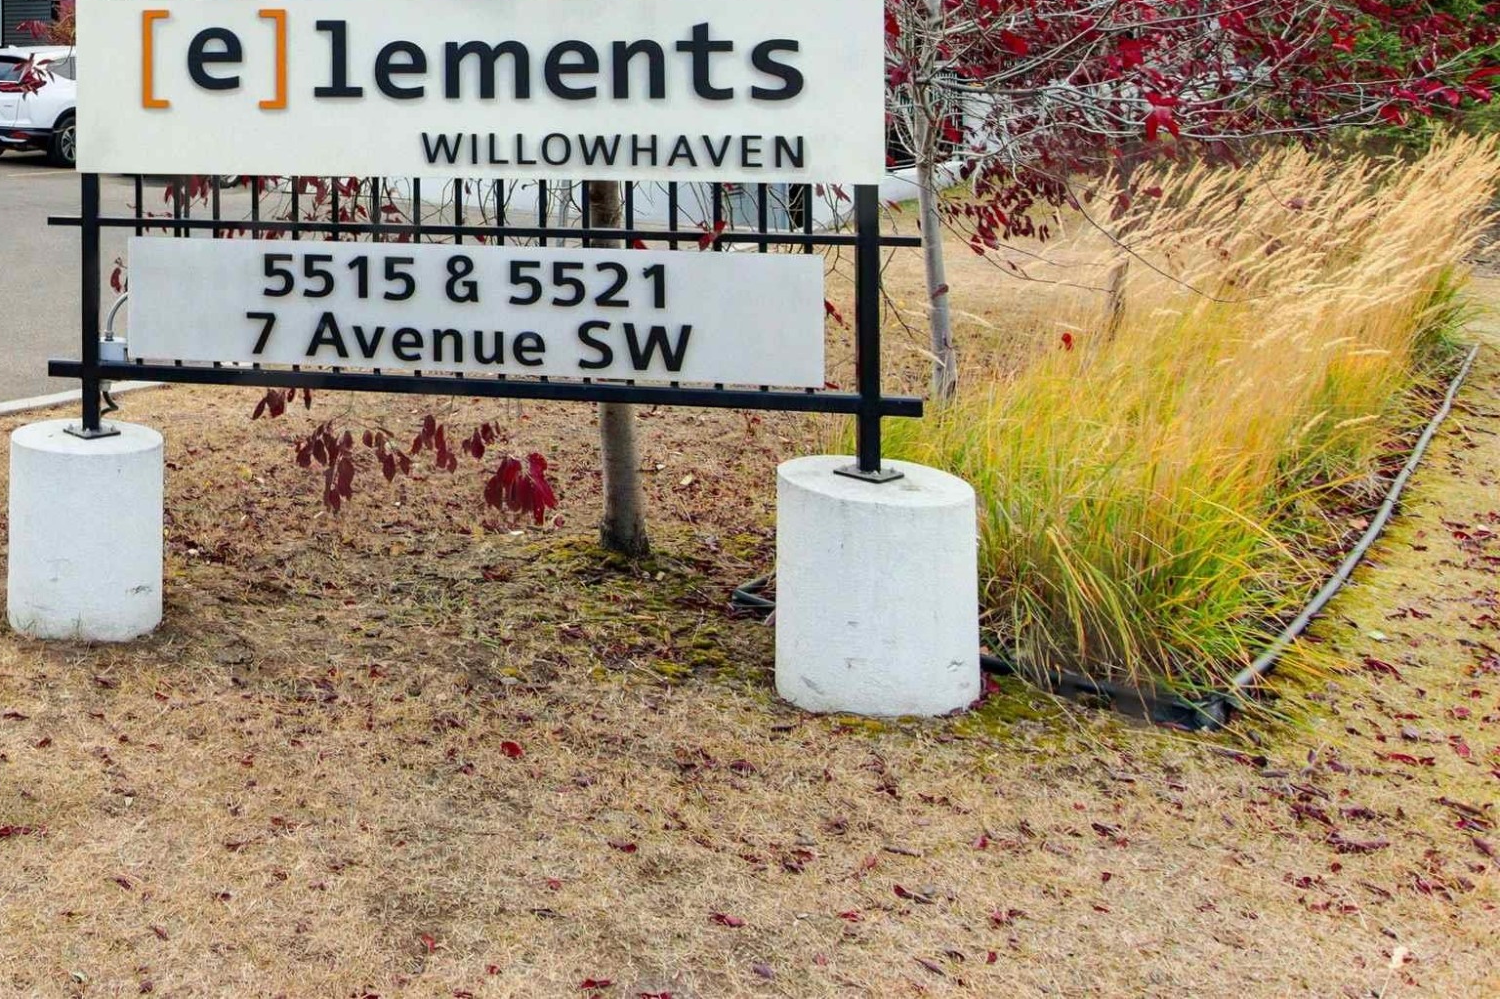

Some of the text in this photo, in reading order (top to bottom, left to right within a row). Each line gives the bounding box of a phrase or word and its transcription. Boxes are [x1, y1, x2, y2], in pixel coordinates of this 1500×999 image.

[420, 131, 805, 170] WILLOWHAVEN
[261, 252, 667, 310] 5515 & 5521
[245, 310, 694, 374] 7 Avenue SW
